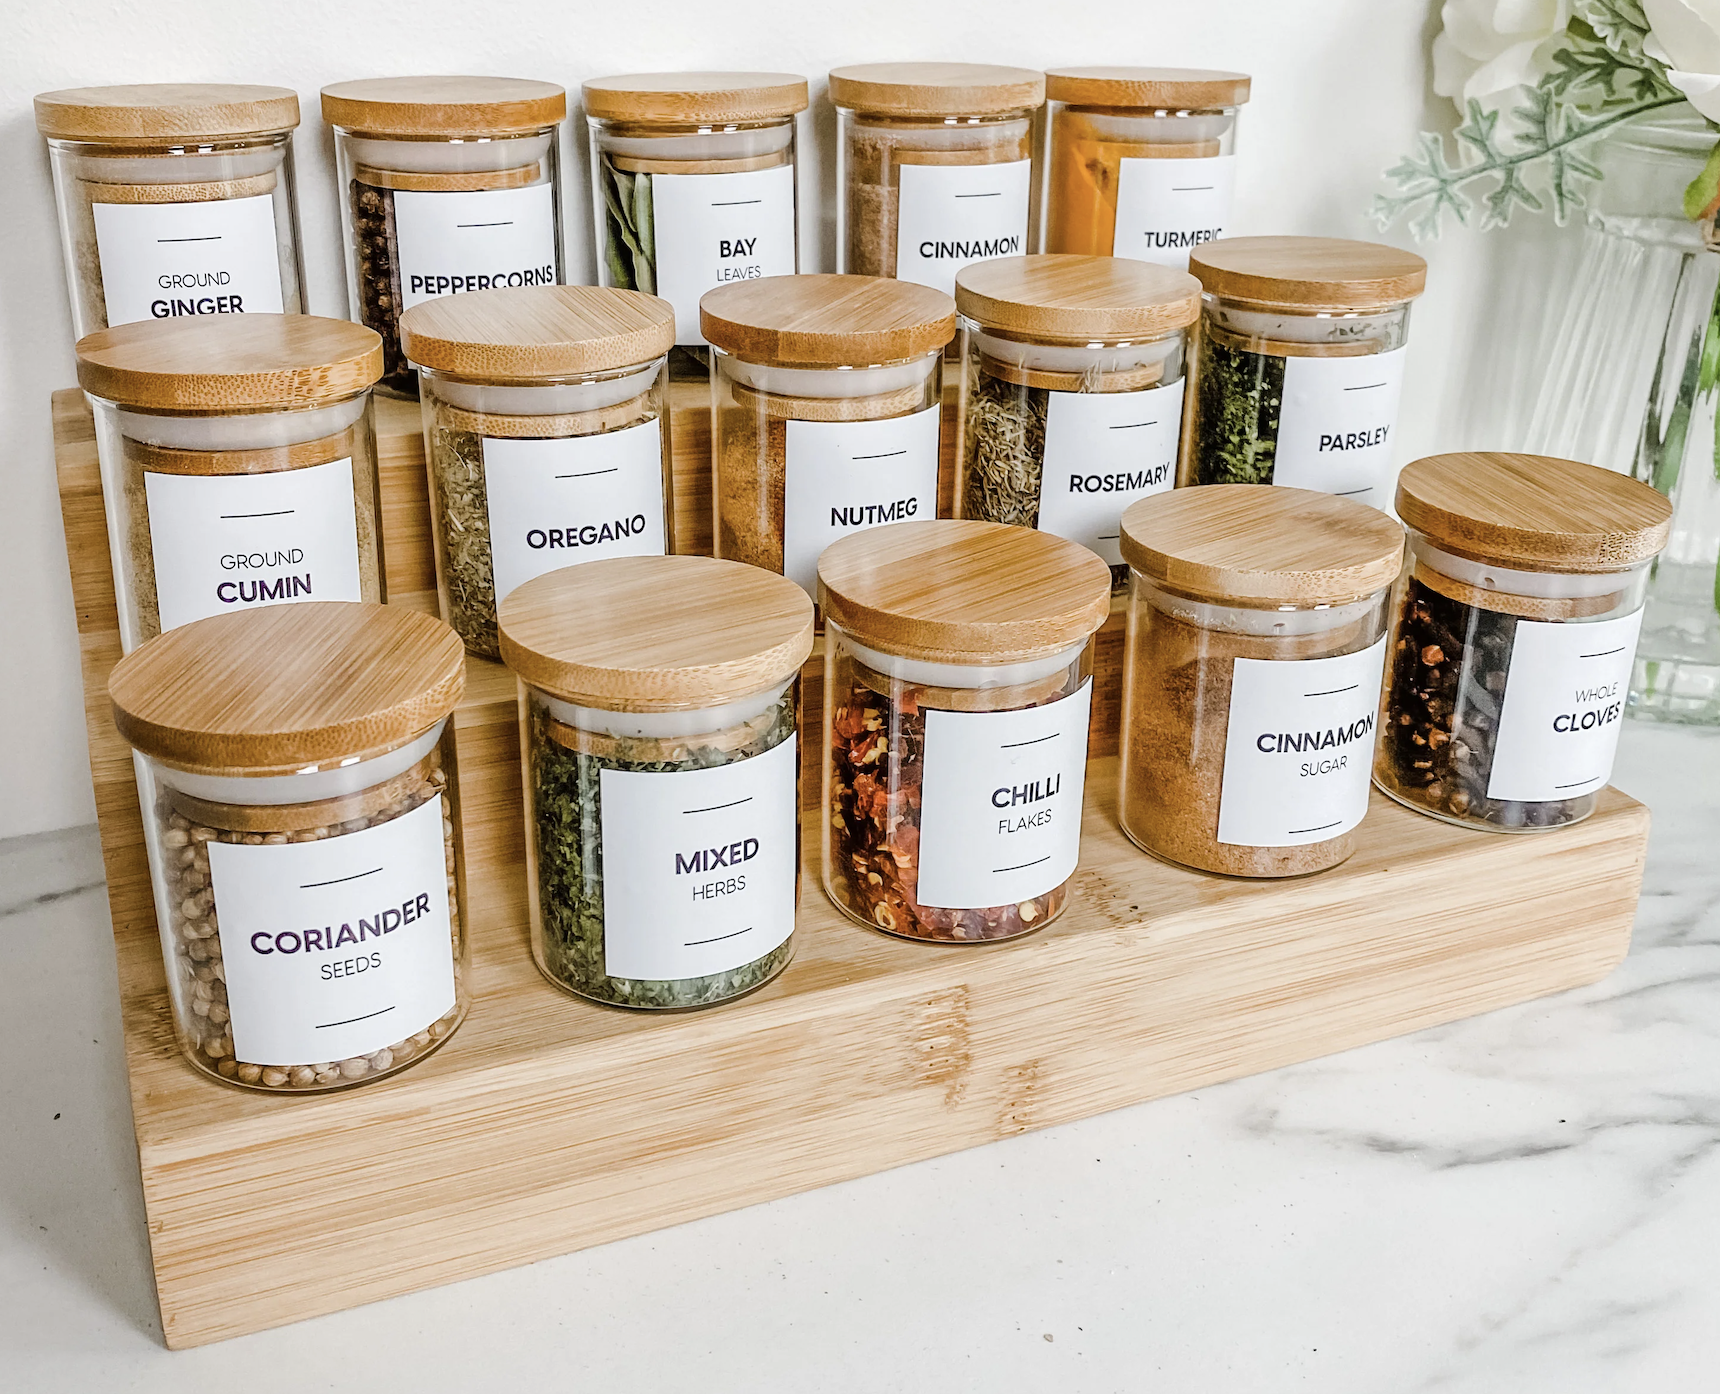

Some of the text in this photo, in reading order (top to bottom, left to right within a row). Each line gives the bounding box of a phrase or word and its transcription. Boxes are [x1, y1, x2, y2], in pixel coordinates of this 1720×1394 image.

[719, 237, 757, 259] BAY
[919, 235, 1019, 259] CINNAMON
[1144, 227, 1223, 248] TURMERIC
[158, 271, 231, 289] GROUND
[410, 264, 553, 295] PEPPERCORNS
[716, 265, 762, 282] LEAVES
[150, 294, 245, 319] GINGER
[1318, 424, 1390, 453] PARSLEY
[1069, 461, 1171, 495] ROSEMARY
[830, 496, 918, 528] NUTMEG
[526, 513, 646, 550] OREGANO
[220, 548, 304, 570] GROUND
[216, 573, 312, 603] CUMIN
[1575, 681, 1618, 704] WHOLE
[1552, 700, 1622, 735] CLOVES
[1256, 710, 1374, 755] CINNAMON
[1299, 755, 1348, 778] SUGAR
[991, 772, 1061, 810] CHILLI
[997, 808, 1052, 836] FLAKES
[674, 837, 760, 876] MIXED
[692, 875, 746, 902] HERBS
[250, 892, 431, 957] CORIANDER
[320, 951, 382, 982] SEEDS
